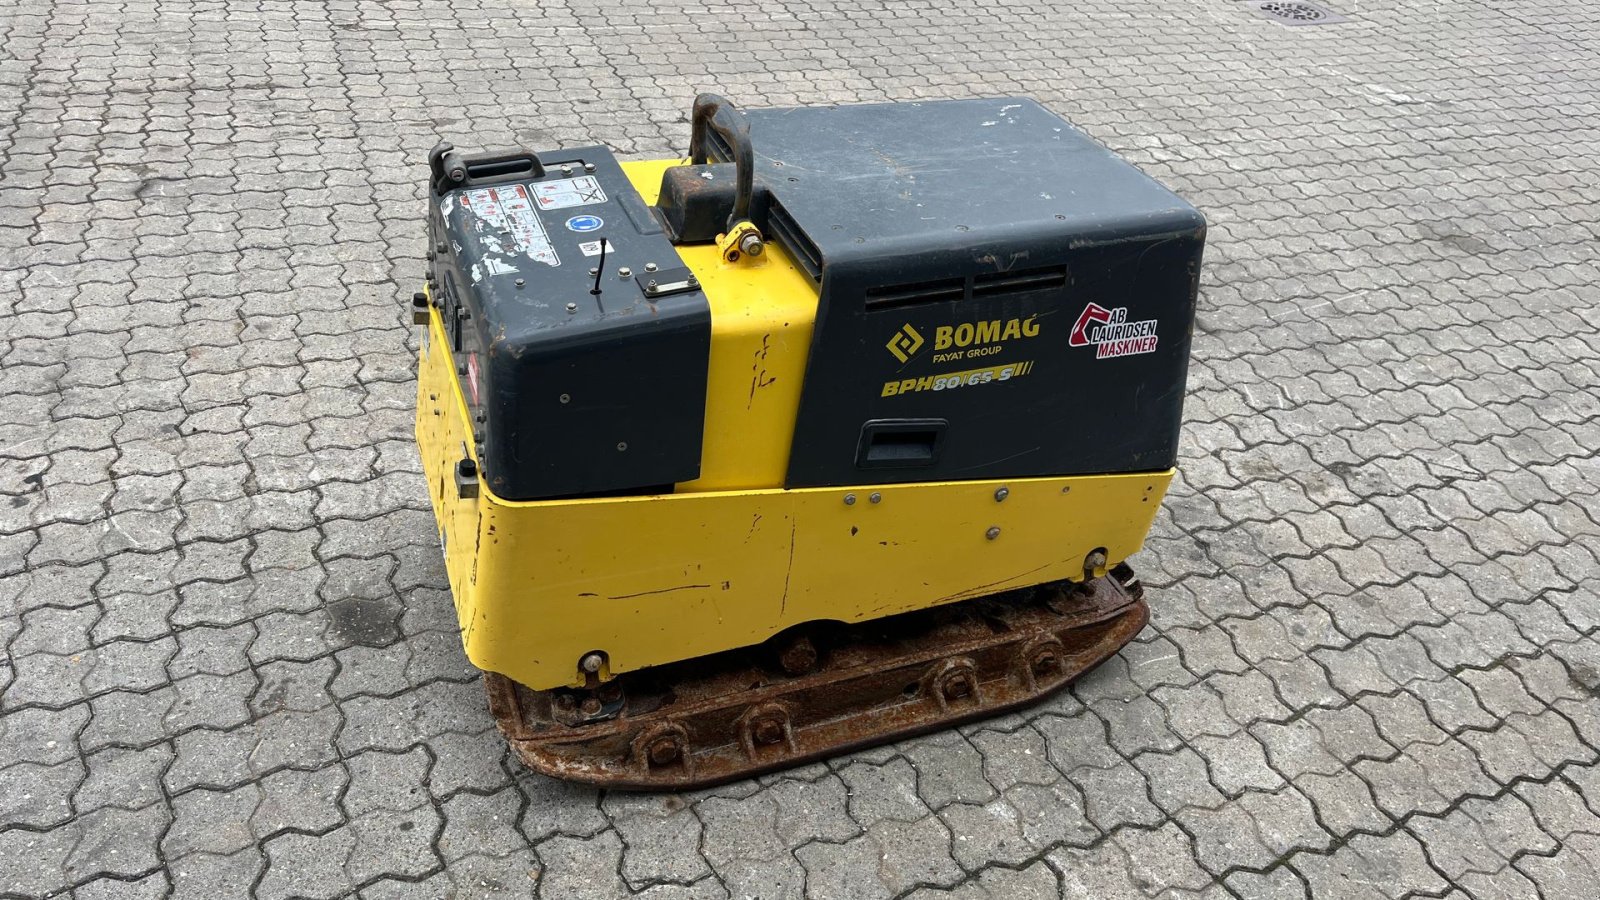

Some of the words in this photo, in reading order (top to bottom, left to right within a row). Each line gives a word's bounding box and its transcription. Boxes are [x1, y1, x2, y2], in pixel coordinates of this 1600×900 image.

[1109, 309, 1126, 324] AB
[934, 317, 1040, 350] BOMAG
[1092, 321, 1156, 342] LAURIDSEN
[933, 351, 964, 363] FAYAT
[967, 346, 1002, 358] GROUP
[1098, 336, 1157, 357] MASKINER
